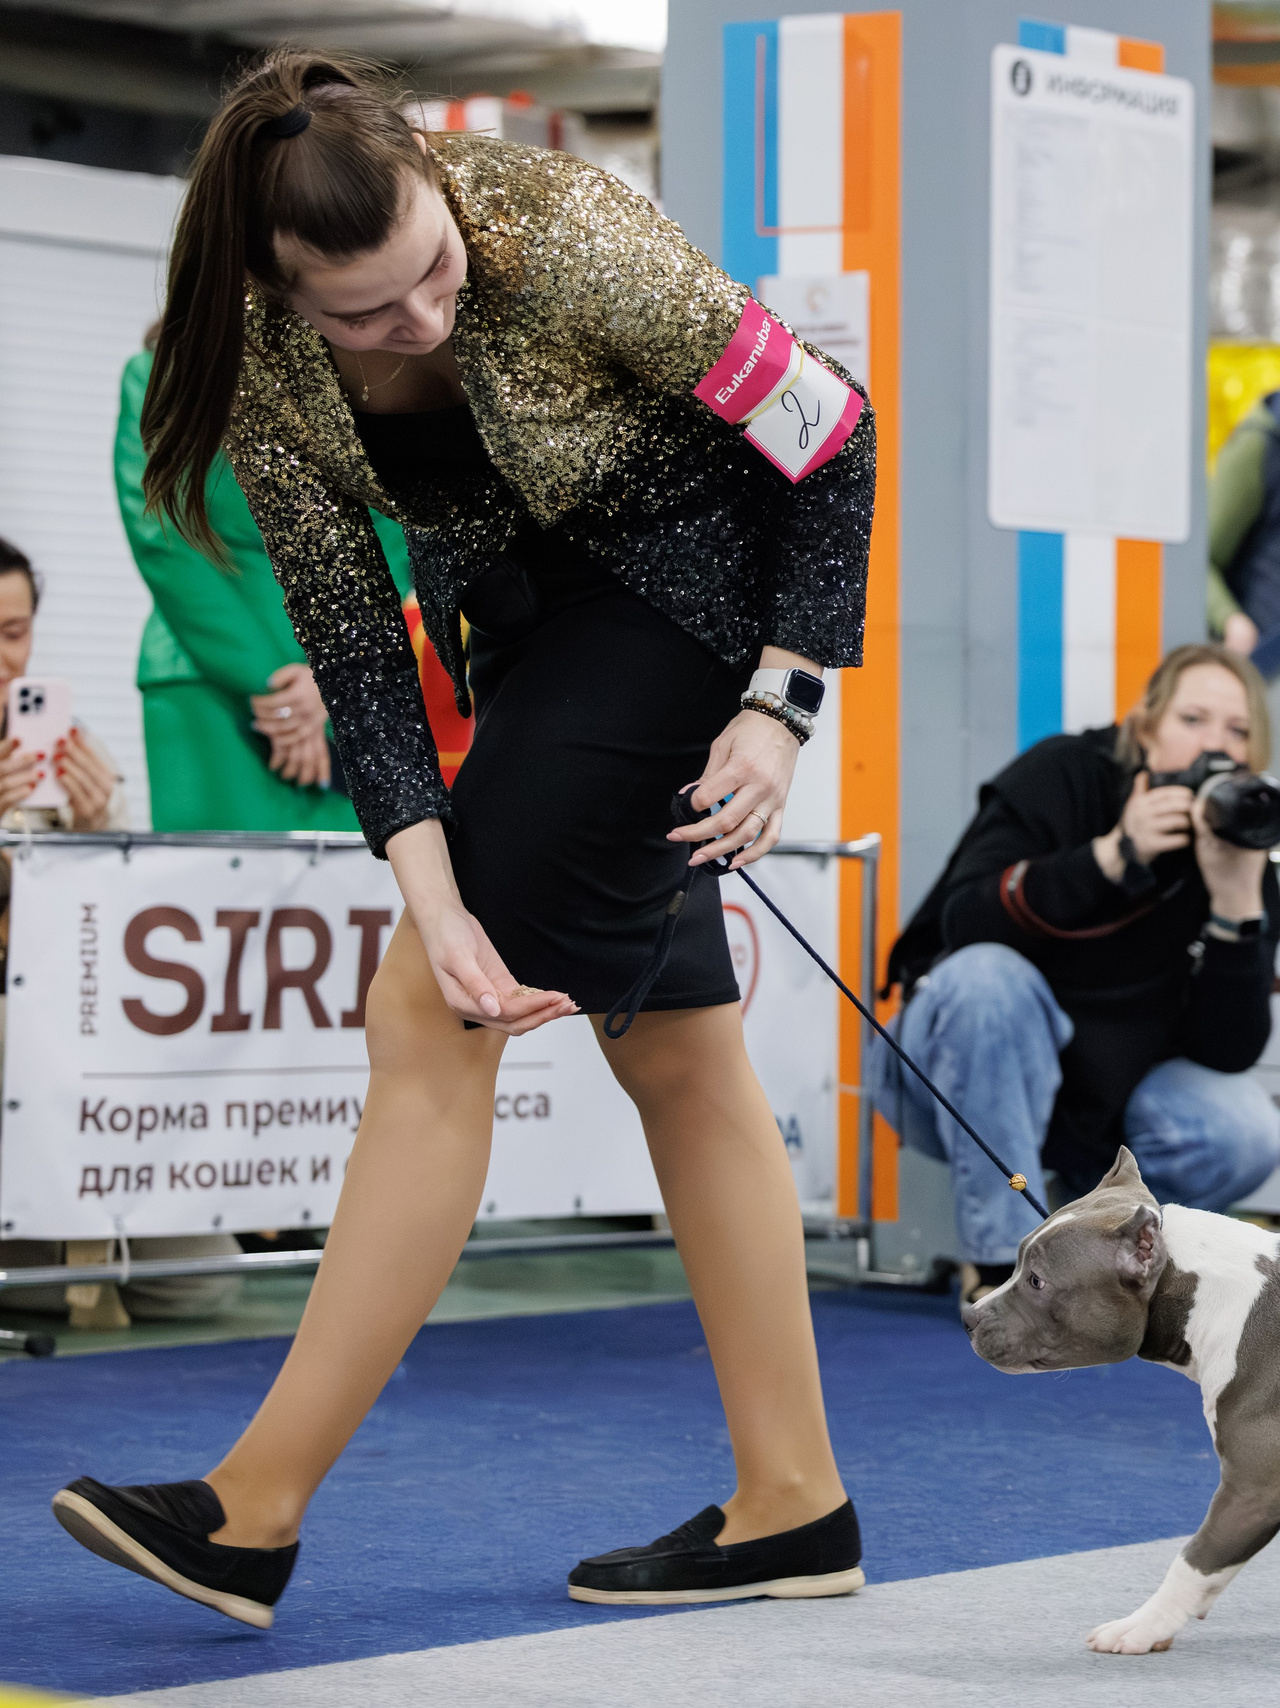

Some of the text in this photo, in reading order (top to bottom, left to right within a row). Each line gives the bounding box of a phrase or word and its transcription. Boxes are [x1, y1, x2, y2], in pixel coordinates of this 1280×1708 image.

[781, 390, 821, 450] 2
[79, 901, 98, 1036] PREMIUM
[121, 905, 393, 1036] SIRI
[79, 1096, 209, 1142] Корма
[79, 1155, 331, 1199] для кошек и
